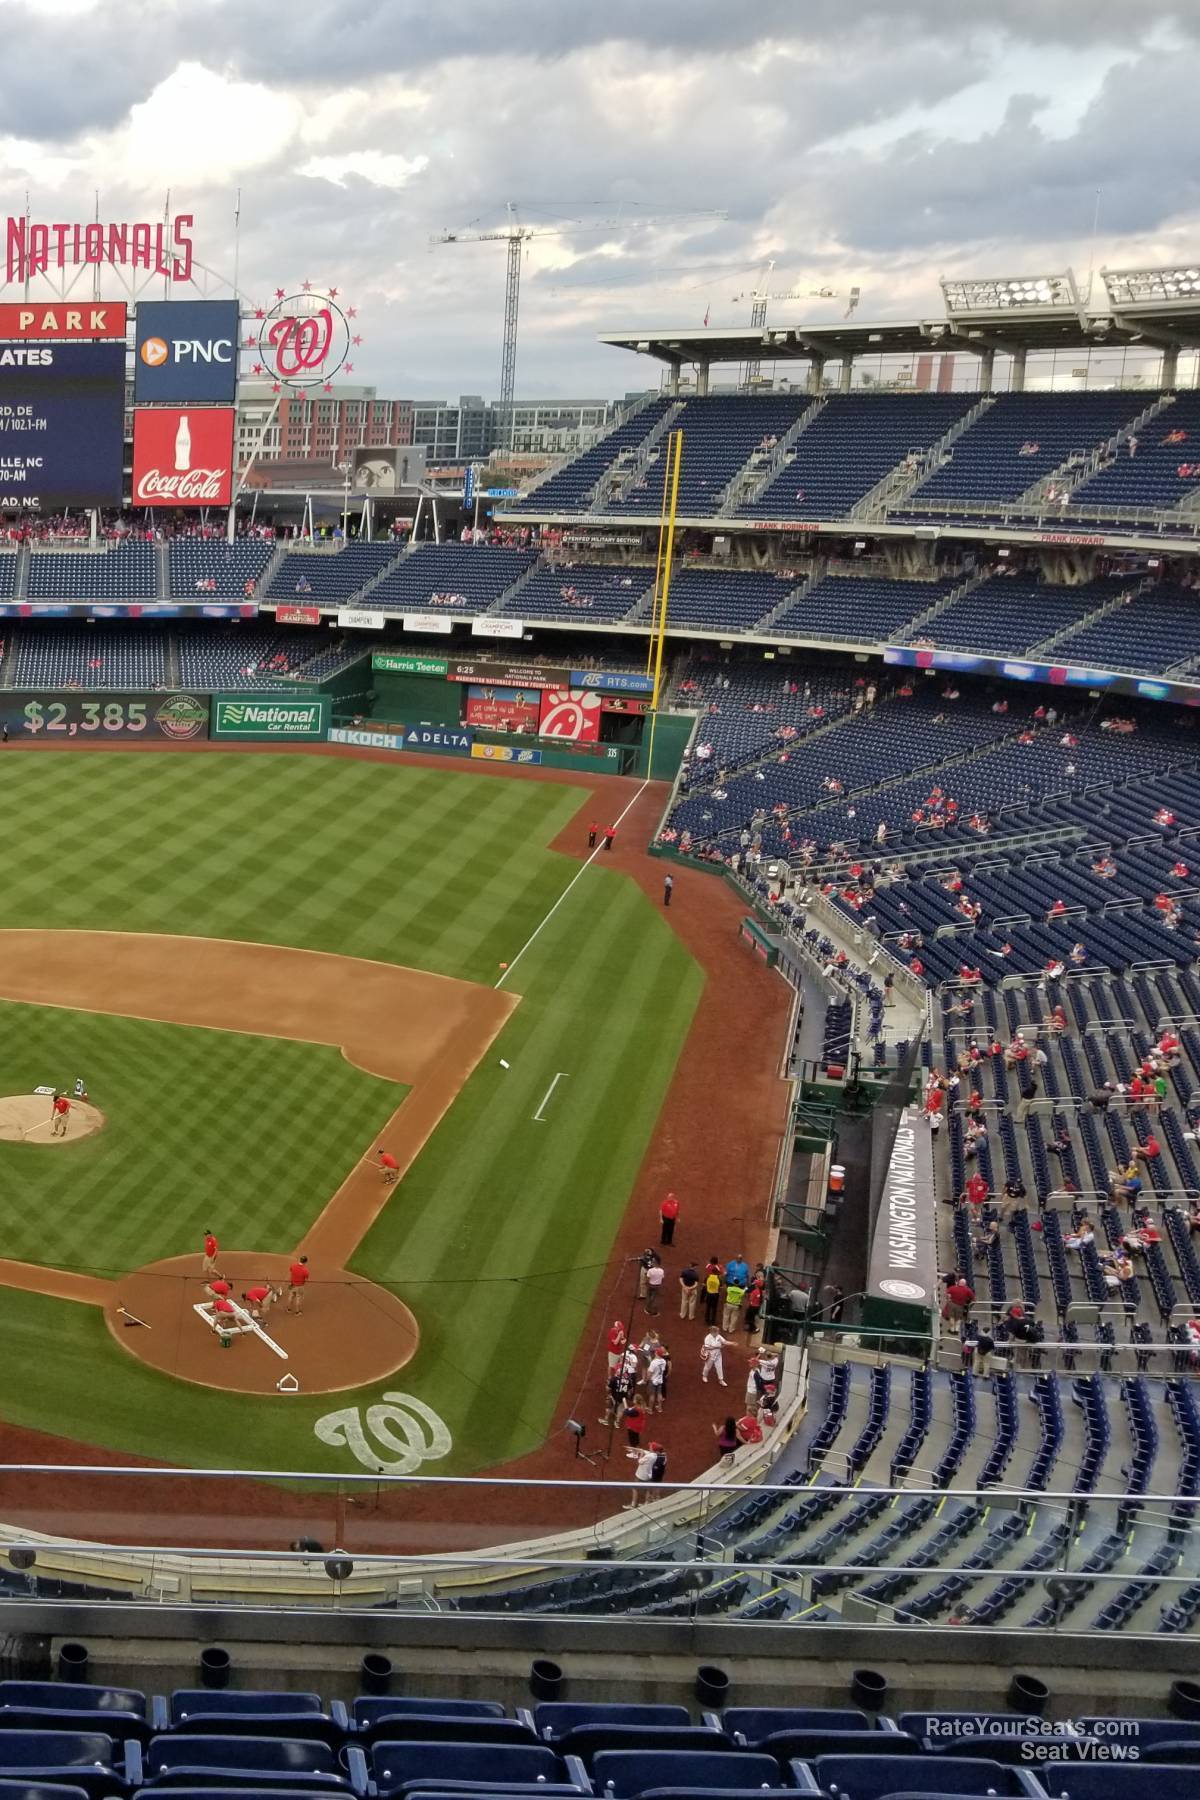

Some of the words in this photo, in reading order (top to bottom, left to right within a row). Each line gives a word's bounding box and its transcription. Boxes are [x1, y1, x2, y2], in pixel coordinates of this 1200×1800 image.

[7, 214, 194, 283] NATIONALS
[19, 311, 107, 331] PARK
[171, 339, 232, 363] PNC
[16, 406, 33, 416] DE
[10, 419, 47, 431] 102.1-FM
[26, 457, 43, 468] NC
[20, 497, 40, 507] NC
[754, 522, 778, 530] FRANK
[781, 523, 820, 531] ROBINSON
[1040, 535, 1066, 543] FRANK
[1069, 536, 1105, 545] HOWARD
[385, 660, 414, 670] Harris
[415, 662, 445, 673] Teeter
[457, 665, 474, 674] 6:25
[455, 676, 485, 684] WASHINGTON
[486, 677, 511, 686] NATIONALS
[504, 673, 532, 681] NATIONALS
[607, 677, 647, 688] RTS.com
[23, 700, 147, 736] $2,385
[243, 706, 315, 723] National
[267, 723, 281, 731] Car
[284, 723, 311, 731] Rental
[347, 730, 397, 748] KOCH
[422, 732, 468, 746] DELTA
[607, 748, 617, 758] 335
[889, 1126, 916, 1186] NATIONALS
[888, 1186, 918, 1269] WASHINGTON
